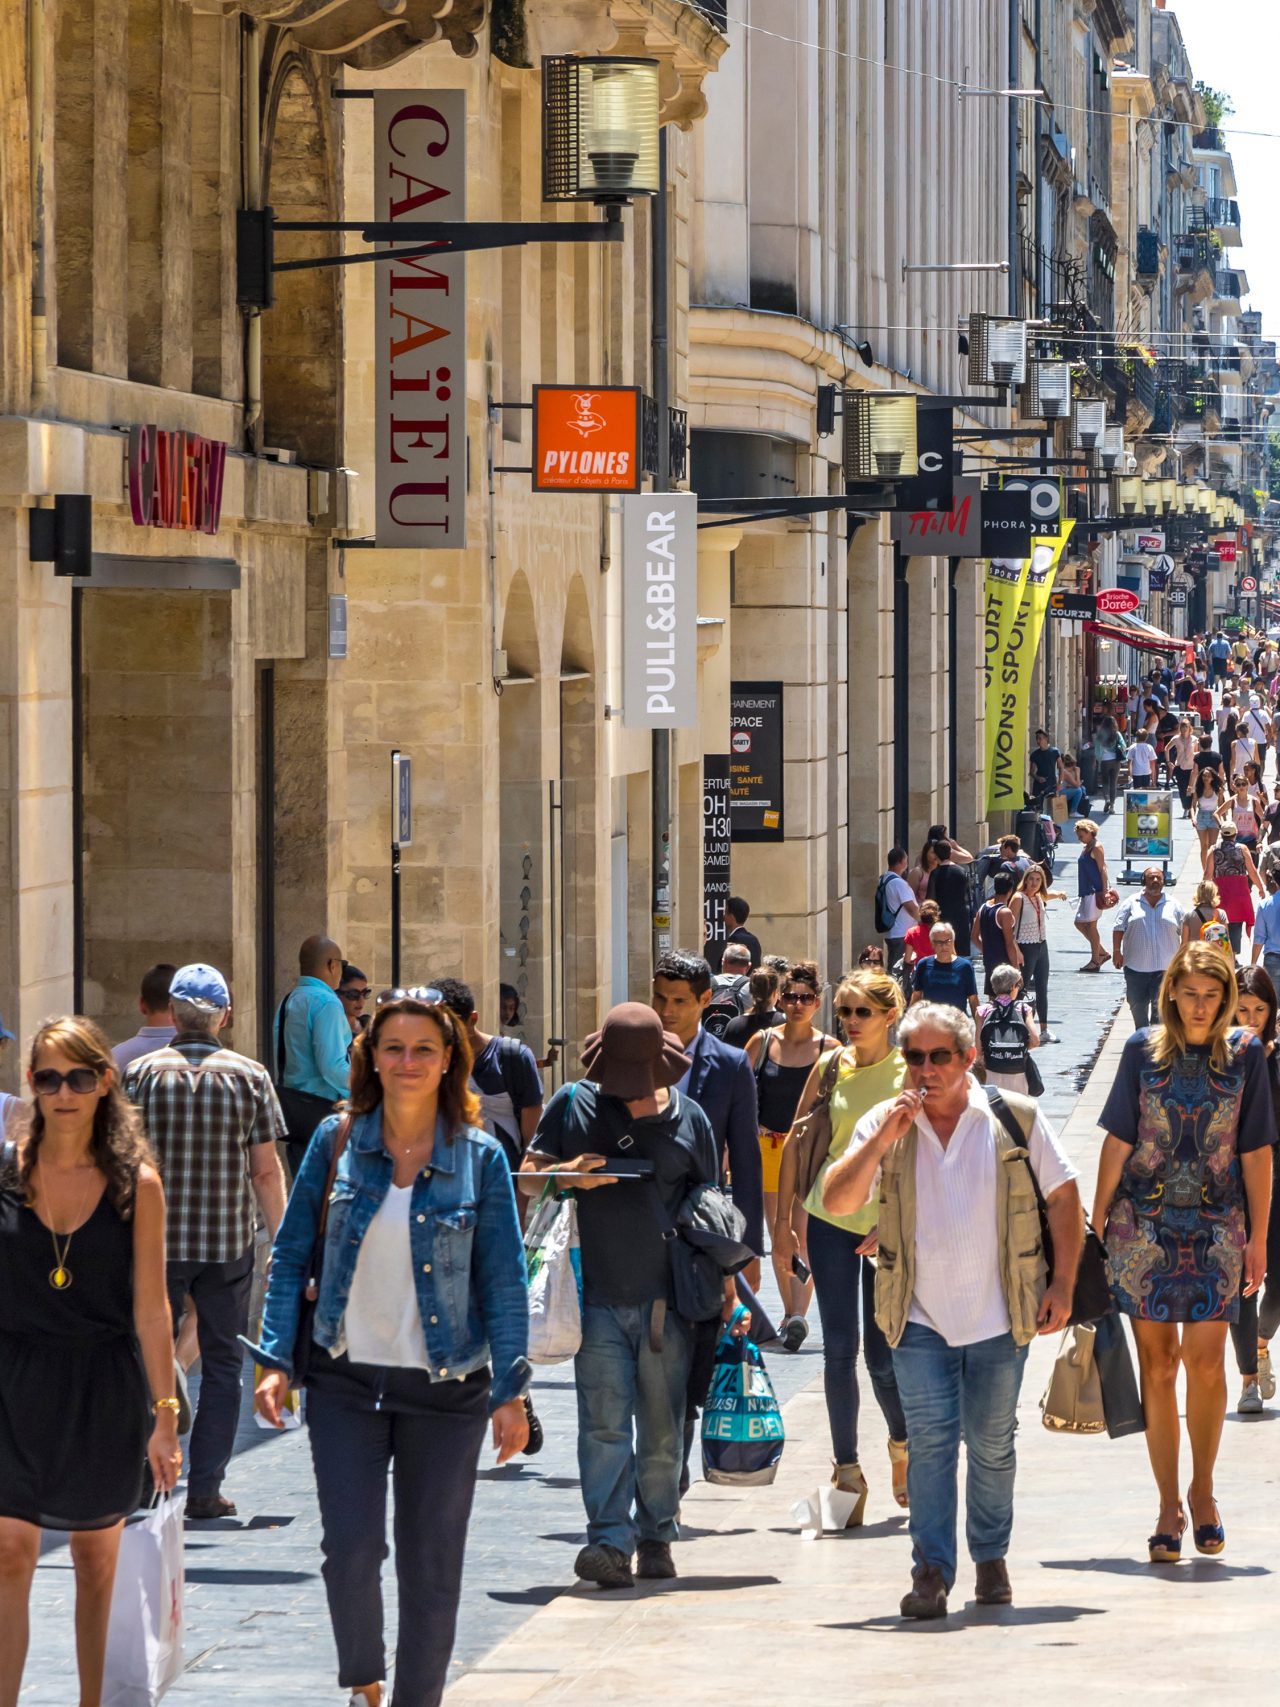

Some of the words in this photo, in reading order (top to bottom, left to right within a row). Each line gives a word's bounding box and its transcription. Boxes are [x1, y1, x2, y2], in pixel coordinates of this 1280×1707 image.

[543, 450, 630, 475] PYLONES
[611, 476, 628, 485] Paris
[1139, 540, 1162, 549] SNCF
[1219, 547, 1236, 555] SFR
[989, 567, 1020, 582] SPORT
[1101, 599, 1134, 610] Dorée
[646, 509, 676, 714] PULL&BEAR
[1050, 608, 1092, 619] COURIR
[994, 693, 1018, 798] VIVONS
[737, 774, 764, 784] SANTÉ
